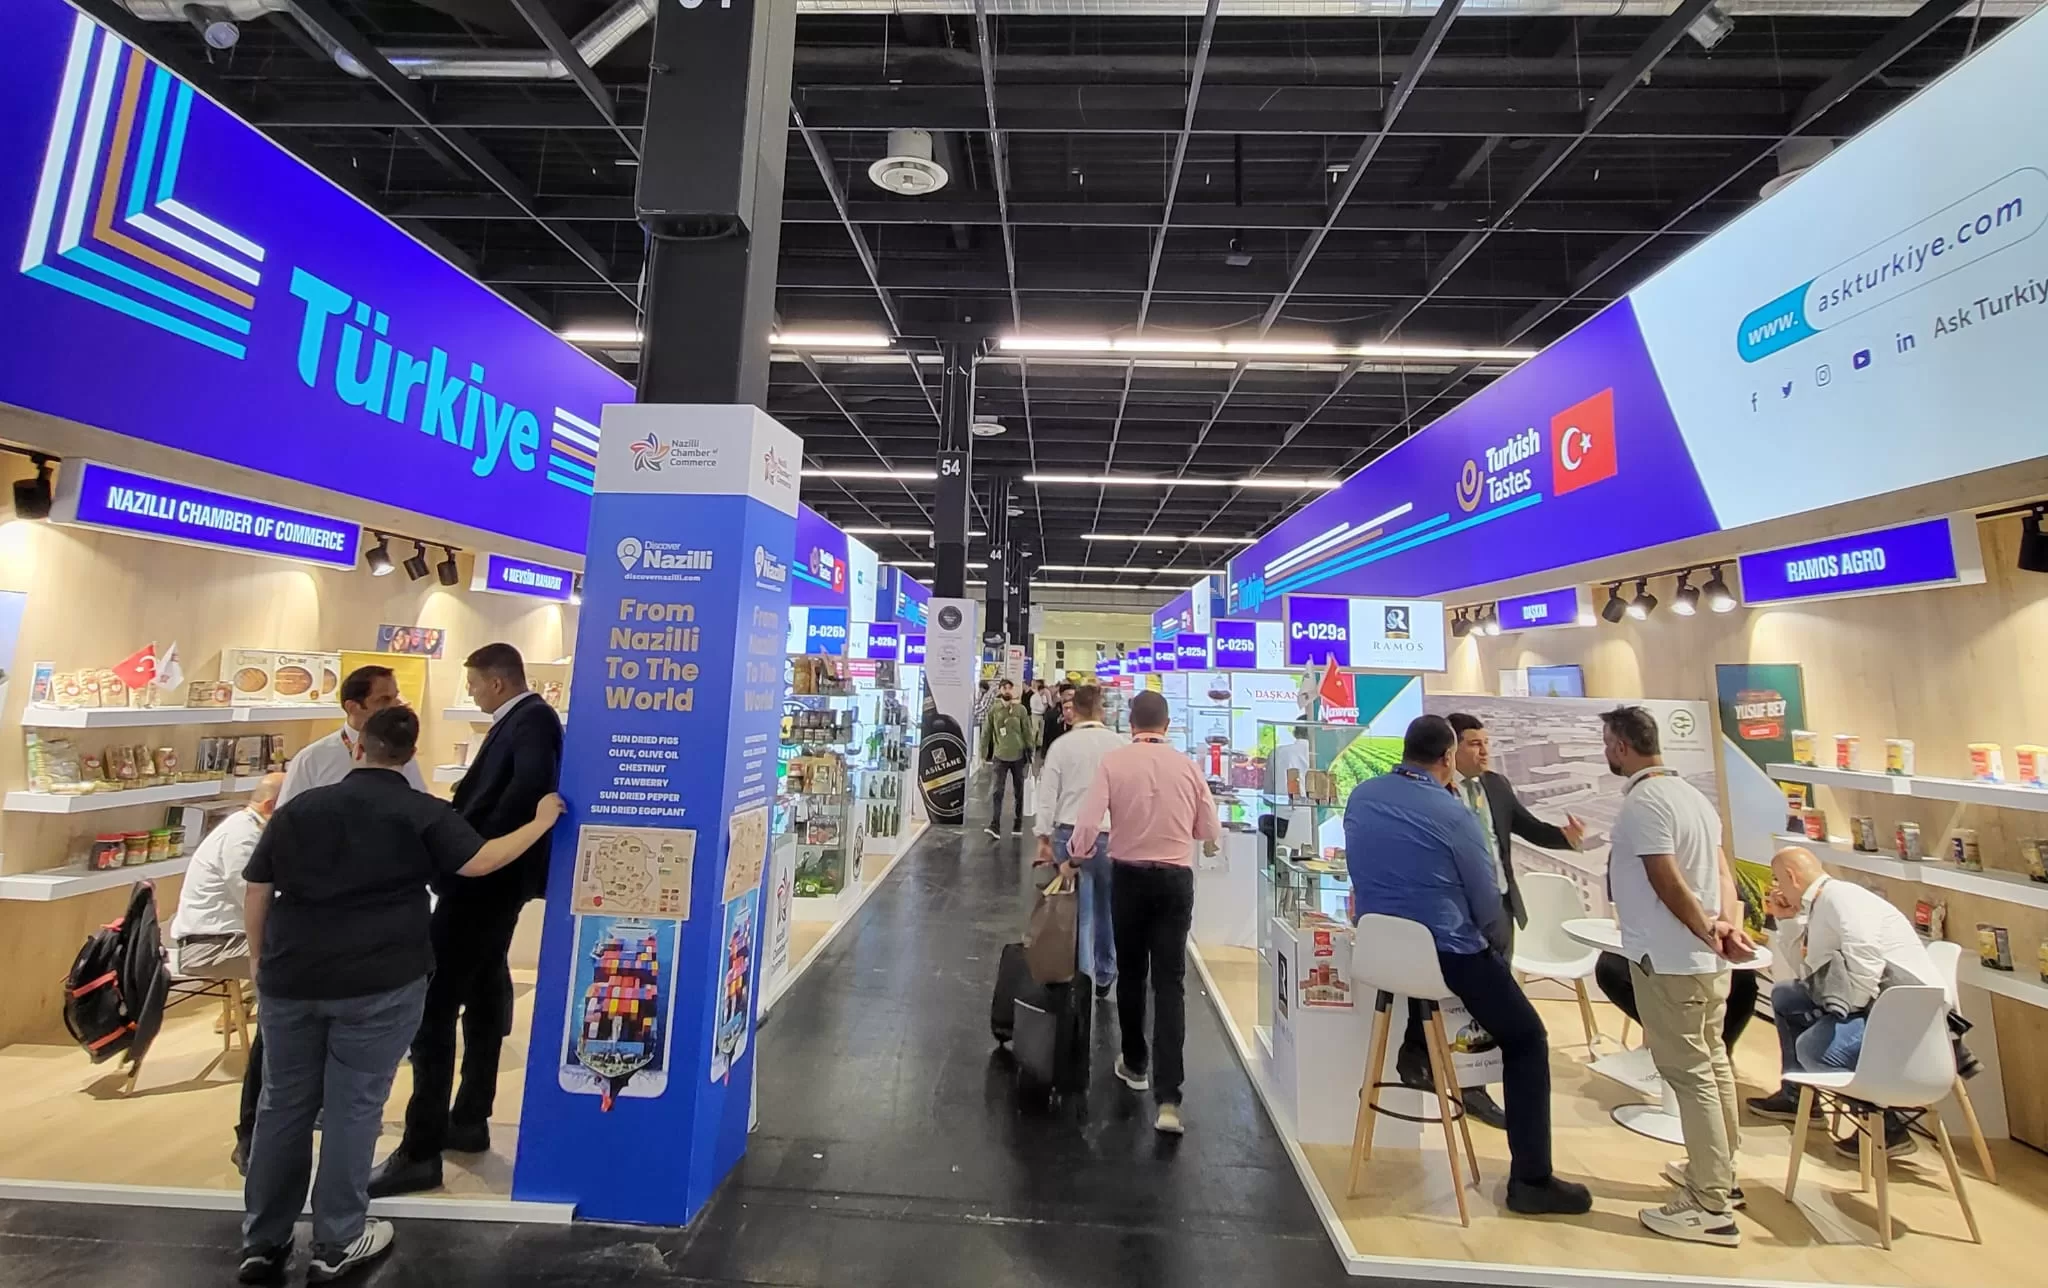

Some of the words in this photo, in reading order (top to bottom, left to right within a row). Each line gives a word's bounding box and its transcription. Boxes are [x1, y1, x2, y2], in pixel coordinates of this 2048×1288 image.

[1748, 311, 1799, 346] www.
[1817, 196, 2023, 312] askturkiye.com
[1934, 307, 1974, 339] Ask
[289, 266, 540, 478] Türkiye
[671, 439, 700, 448] Nazilli
[1485, 427, 1541, 474] Turkish
[670, 448, 711, 457] Chamber
[669, 458, 717, 467] Commerce
[941, 459, 961, 476] 54
[1486, 468, 1532, 504] Tastes
[106, 485, 177, 520] NAZILLI
[178, 499, 253, 535] CHAMBER
[254, 516, 273, 537] OF
[275, 520, 346, 551] COMMERCE
[644, 540, 681, 551] Discover
[643, 549, 713, 570] Nazilli
[990, 550, 1002, 560] 44
[1786, 558, 1838, 583] RAMOS
[1841, 547, 1886, 576] AGRO
[619, 599, 695, 622] From
[610, 627, 700, 652] Nazilli
[808, 624, 846, 638] B-026b
[1292, 622, 1347, 641] C-029a
[1216, 638, 1255, 651] C-025b
[1373, 640, 1424, 652] RAMOS
[605, 656, 640, 679] To
[646, 658, 700, 681] The
[605, 686, 694, 712] World
[1734, 702, 1767, 720] YUSUF
[611, 734, 630, 743] SUN
[631, 736, 657, 745] DRIED
[658, 737, 679, 745] FIGS
[608, 748, 637, 759] OLIVE,
[638, 750, 664, 759] OLIVE
[664, 751, 680, 760] OIL
[618, 763, 667, 773] CHESTNUT
[925, 757, 962, 776] ASILTANE
[613, 777, 669, 788] STAWBERRY
[599, 791, 619, 800] SUN
[619, 792, 646, 801] DRIED
[646, 793, 680, 802] PEPPER
[590, 805, 610, 814] SUN
[610, 806, 637, 815] DRIED
[638, 807, 686, 817] EGGPLANT
